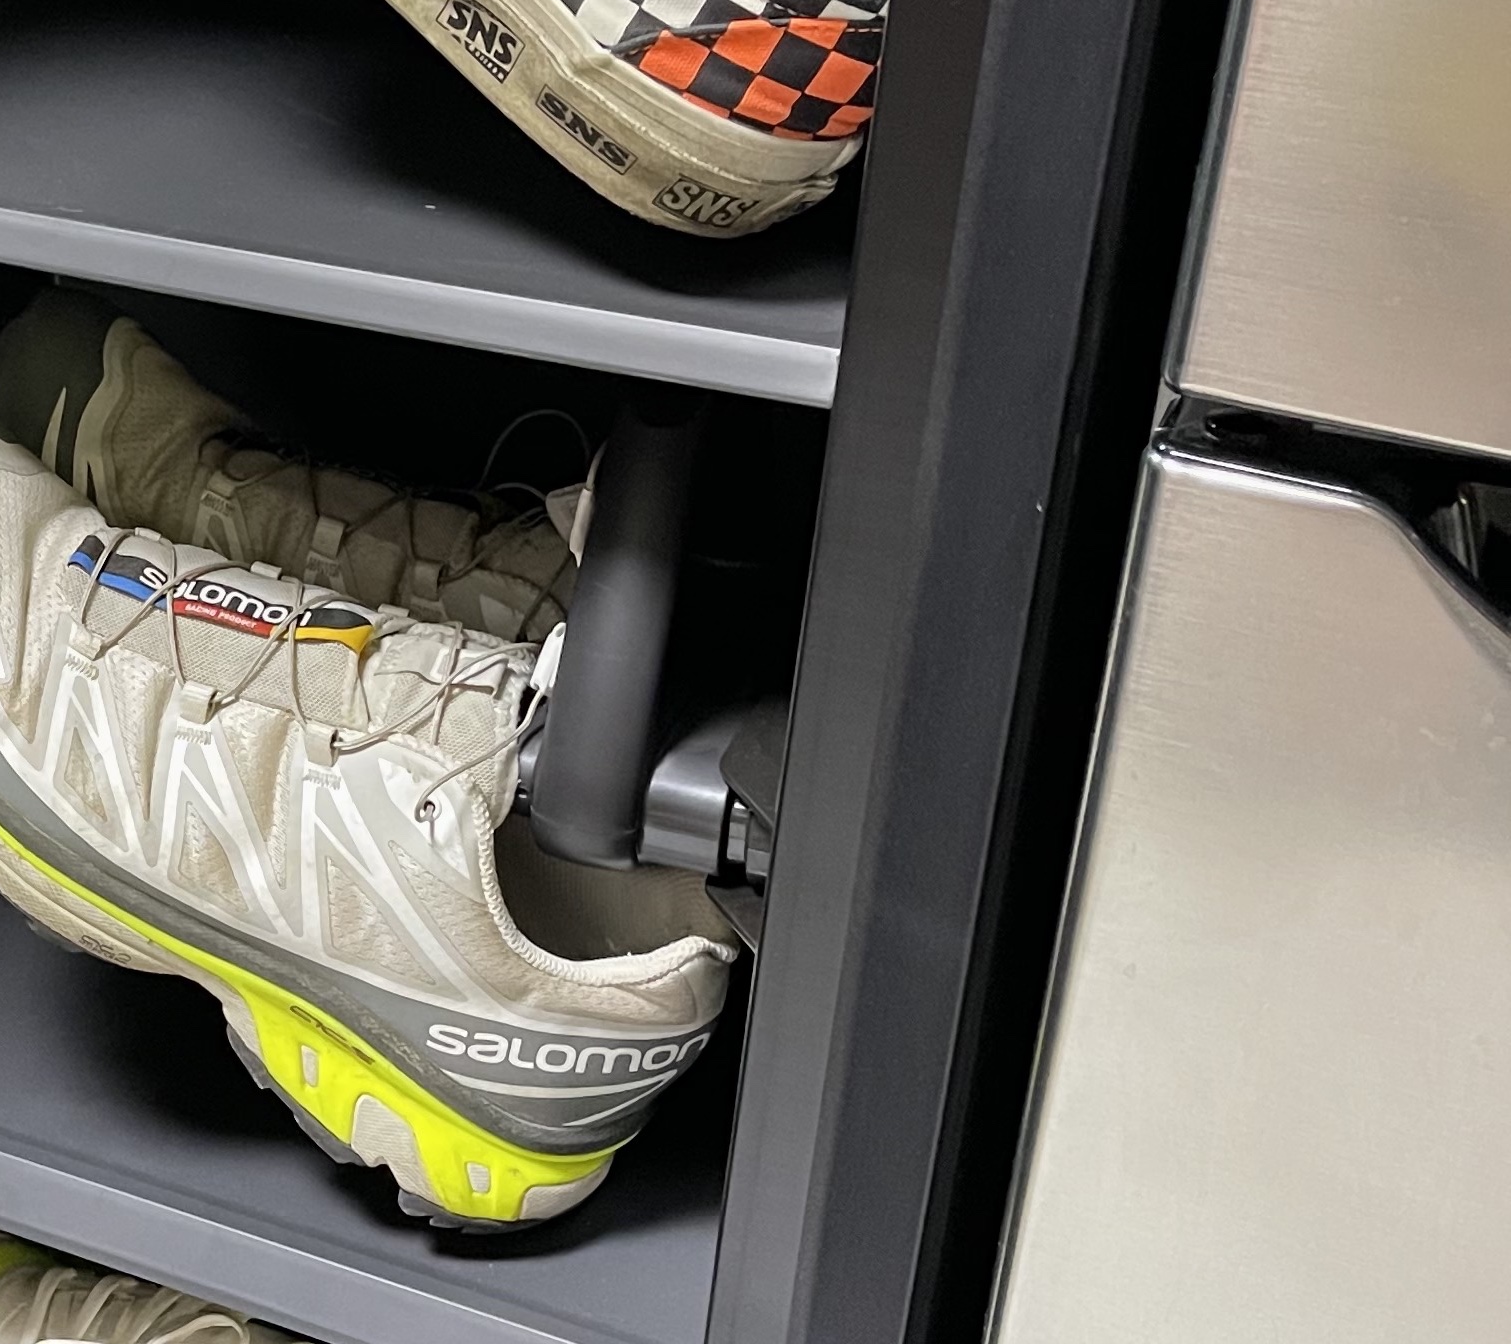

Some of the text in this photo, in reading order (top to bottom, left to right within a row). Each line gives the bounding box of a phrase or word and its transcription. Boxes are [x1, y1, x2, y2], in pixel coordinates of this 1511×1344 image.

[447, 0, 518, 65] SNS
[540, 92, 630, 167] SNS
[662, 180, 755, 226] SNS
